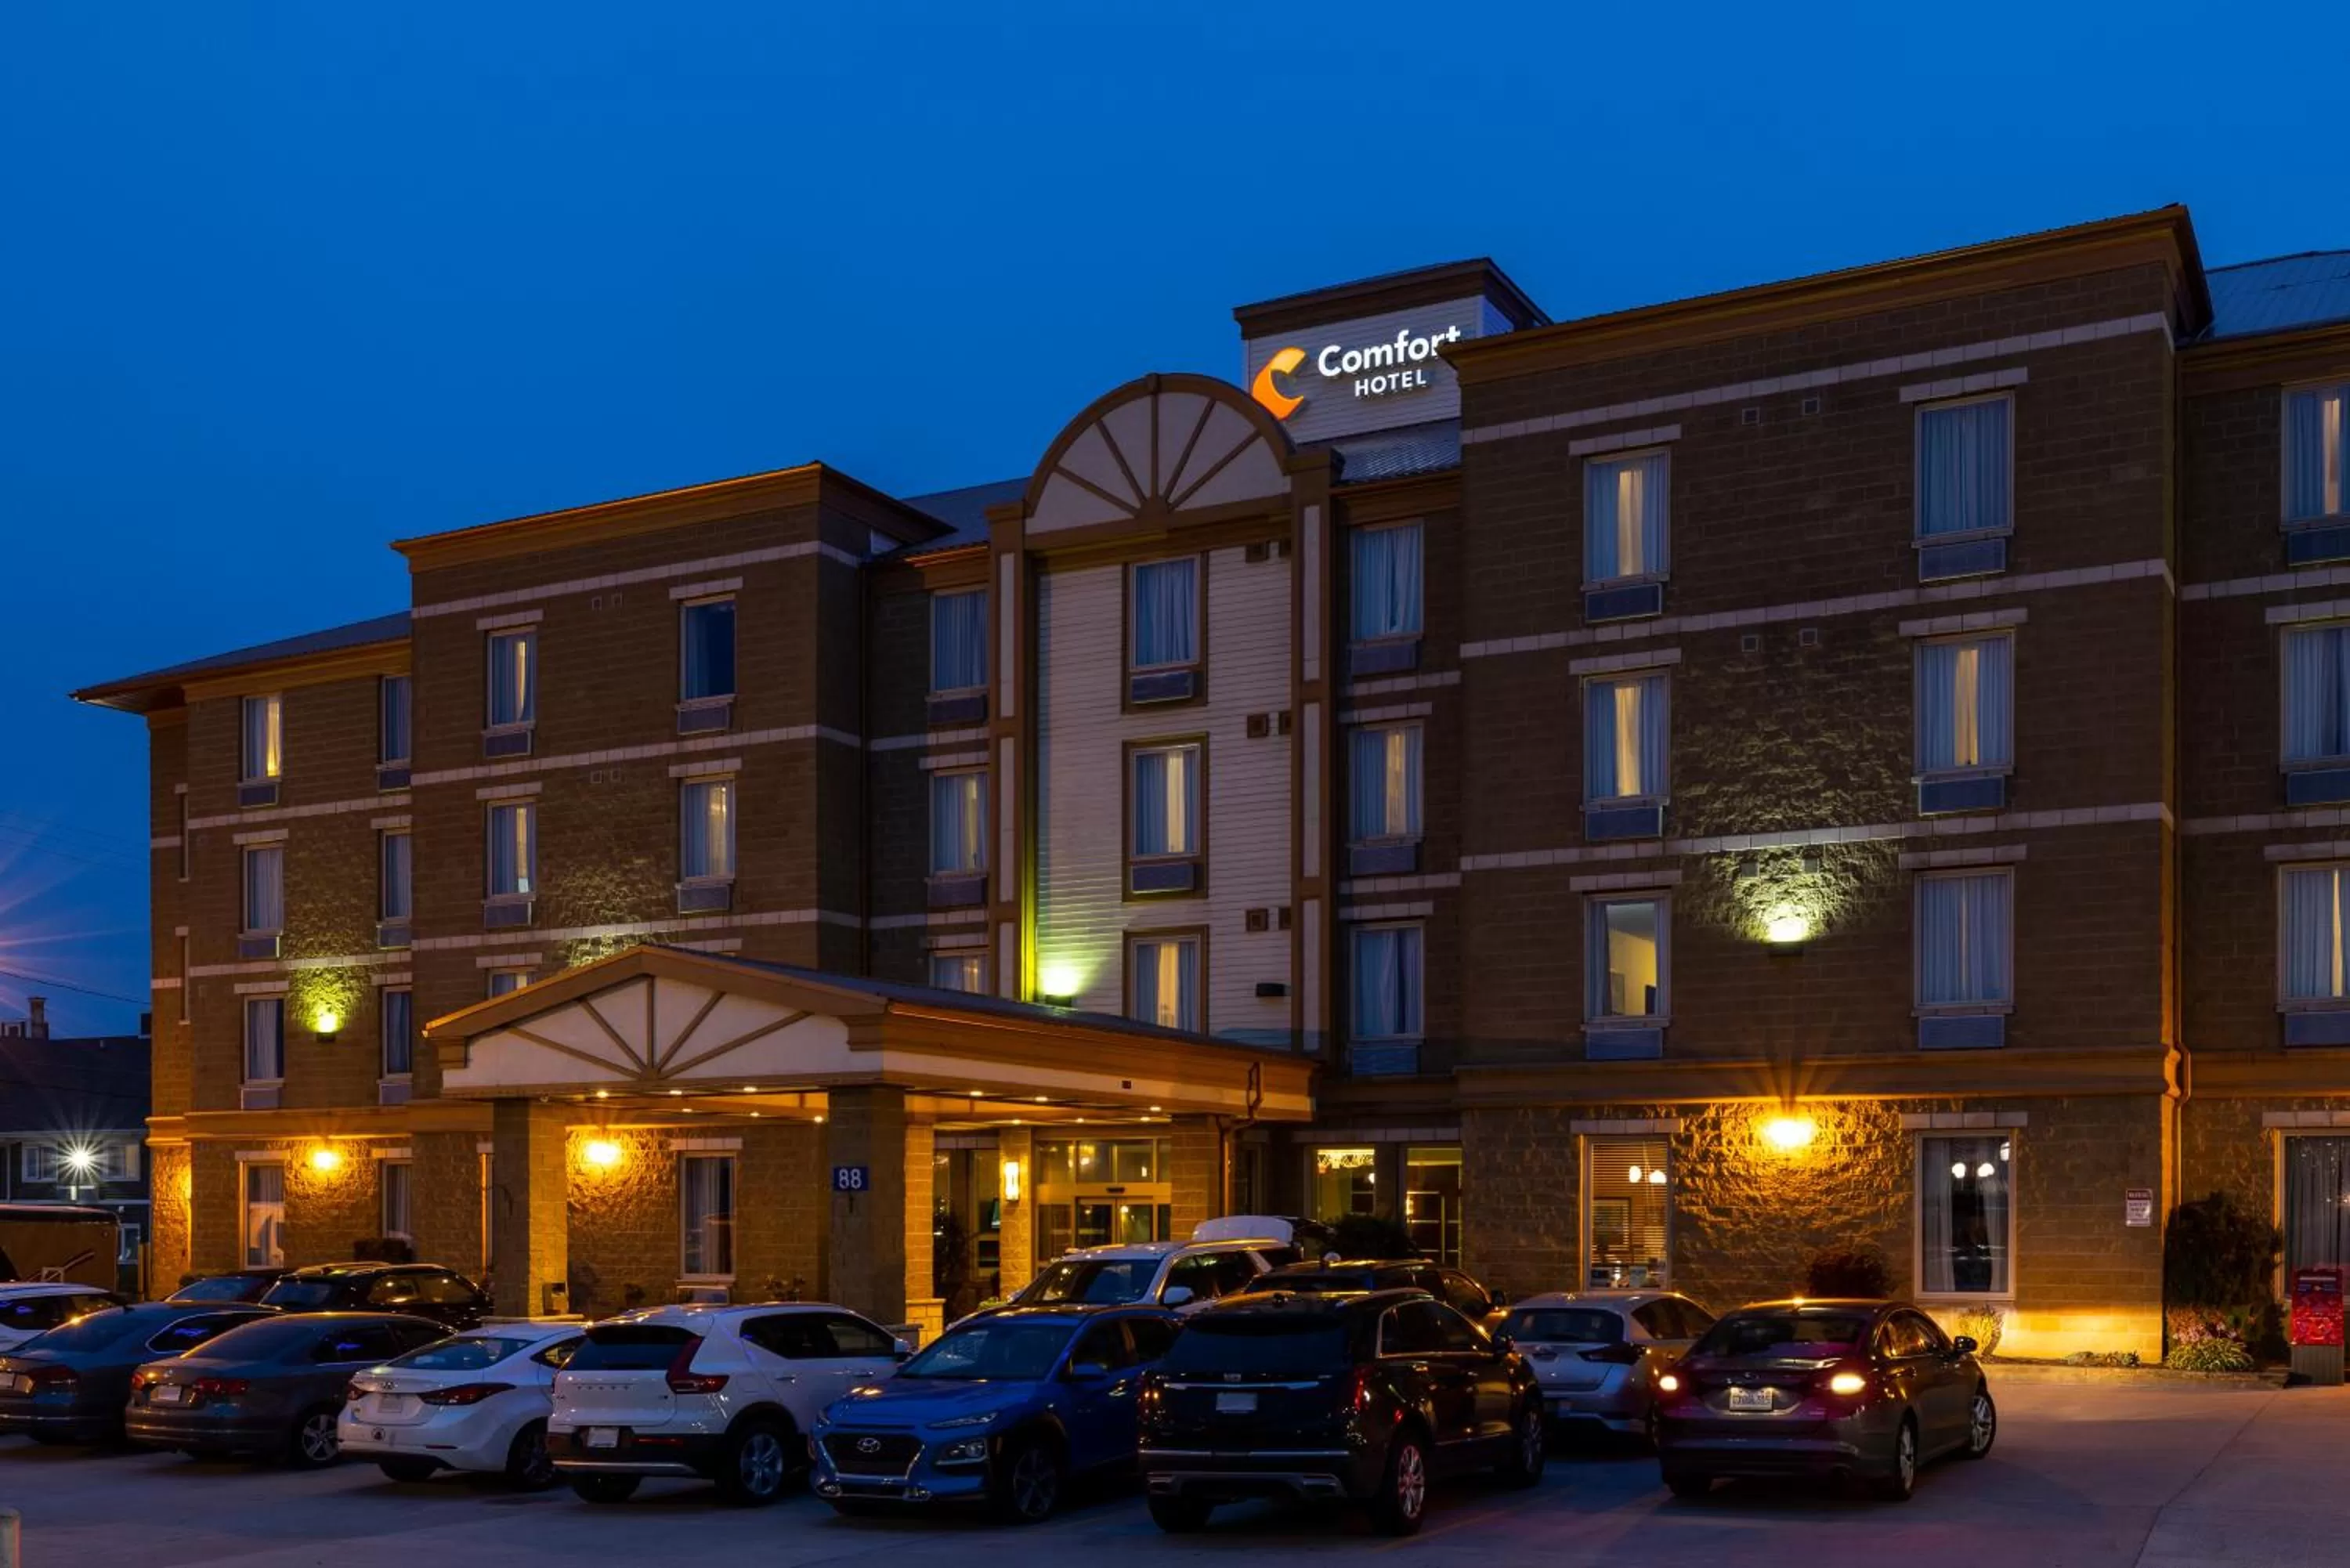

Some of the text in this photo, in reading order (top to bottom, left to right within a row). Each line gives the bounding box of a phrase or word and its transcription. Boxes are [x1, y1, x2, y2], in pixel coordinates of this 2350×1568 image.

[1318, 325, 1461, 377] Comfort
[1354, 369, 1426, 396] HOTEL
[839, 1168, 862, 1189] 88
